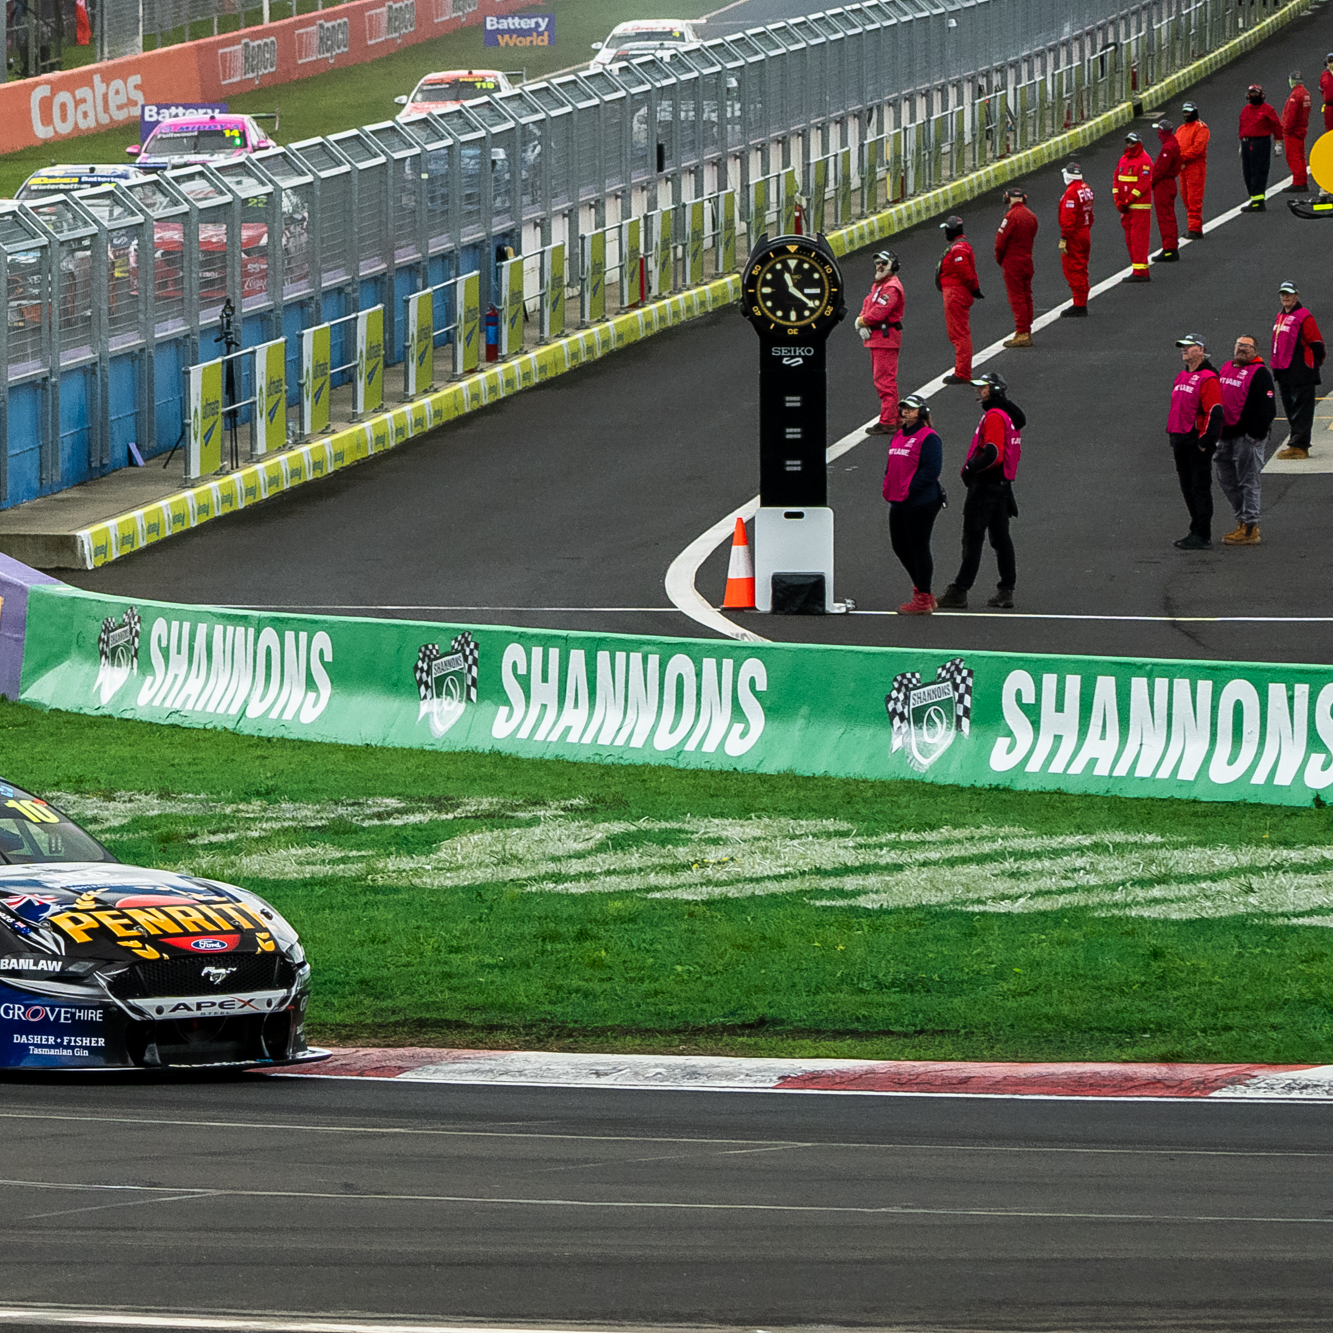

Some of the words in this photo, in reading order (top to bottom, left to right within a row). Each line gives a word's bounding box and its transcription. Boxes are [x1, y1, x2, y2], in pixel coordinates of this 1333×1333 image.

[486, 15, 549, 32] Battery
[496, 32, 549, 46] World
[30, 72, 145, 140] Coates
[223, 129, 240, 137] 14
[771, 346, 814, 356] SEIKO
[136, 616, 332, 726] SHANNONS
[433, 652, 463, 675] SHANNONS
[492, 641, 768, 757] SHANNONS
[910, 683, 952, 709] SHANNONS
[5, 799, 61, 824] 10
[198, 940, 222, 950] Ford
[0, 959, 62, 972] BANLAW
[0, 1003, 72, 1024] GROVE
[76, 1009, 103, 1022] HIRE
[168, 996, 261, 1014] APEX
[13, 1034, 56, 1045] DASHER
[63, 1036, 105, 1047] FISHER
[29, 1046, 72, 1056] Tasmanian
[74, 1047, 89, 1057] Gin
